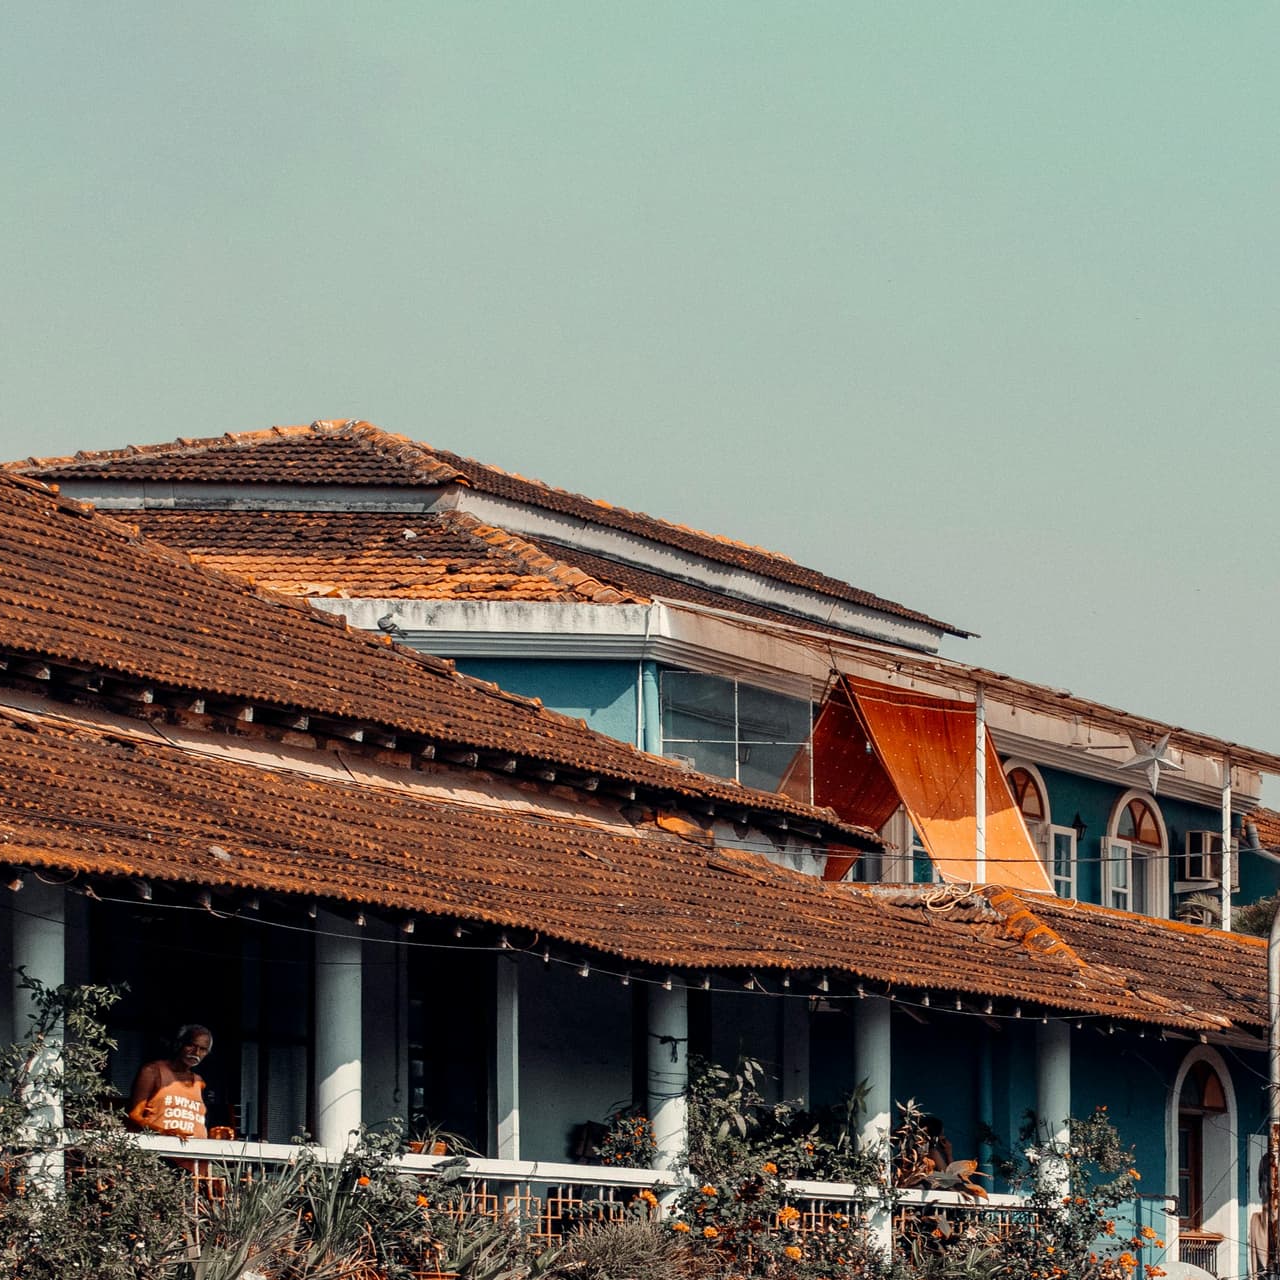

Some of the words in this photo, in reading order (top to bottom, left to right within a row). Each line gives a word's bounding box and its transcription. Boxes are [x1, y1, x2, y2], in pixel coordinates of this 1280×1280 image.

[174, 1096, 200, 1111] WHAT
[164, 1107, 195, 1120] GOES
[163, 1119, 194, 1133] TOUR
